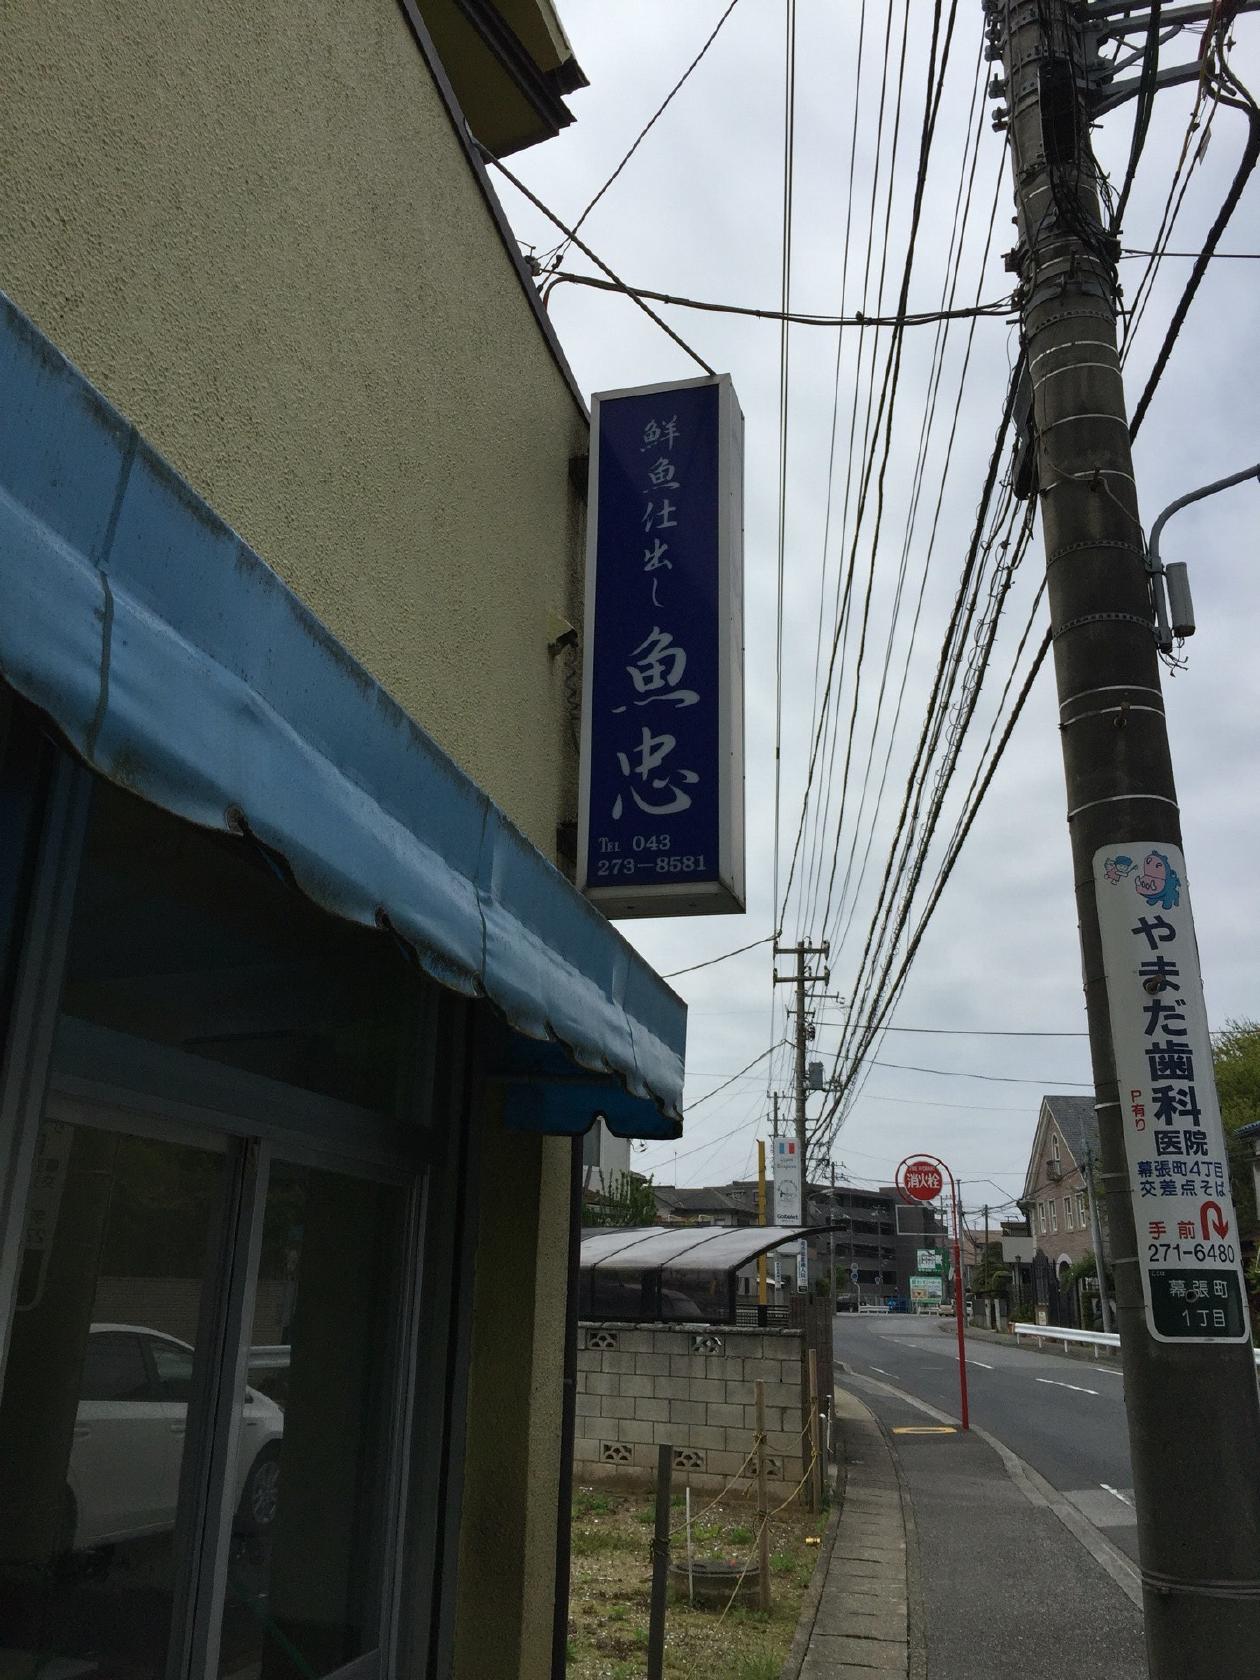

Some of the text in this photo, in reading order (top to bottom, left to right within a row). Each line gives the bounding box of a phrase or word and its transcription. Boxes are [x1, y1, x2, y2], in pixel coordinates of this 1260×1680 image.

[640, 414, 680, 608] 鮮魚仕出し
[611, 625, 700, 821] 魚忠
[632, 834, 671, 851] 043
[597, 855, 706, 876] 273-8581
[1137, 1160, 1224, 1179] 幕張町4丁目
[906, 1172, 940, 1189] 消火栓
[1148, 1221, 1196, 1240] 手前
[1148, 1243, 1235, 1263] 271-6480
[1168, 1280, 1228, 1298] 幕張町
[1182, 1309, 1226, 1327] 1丁目
